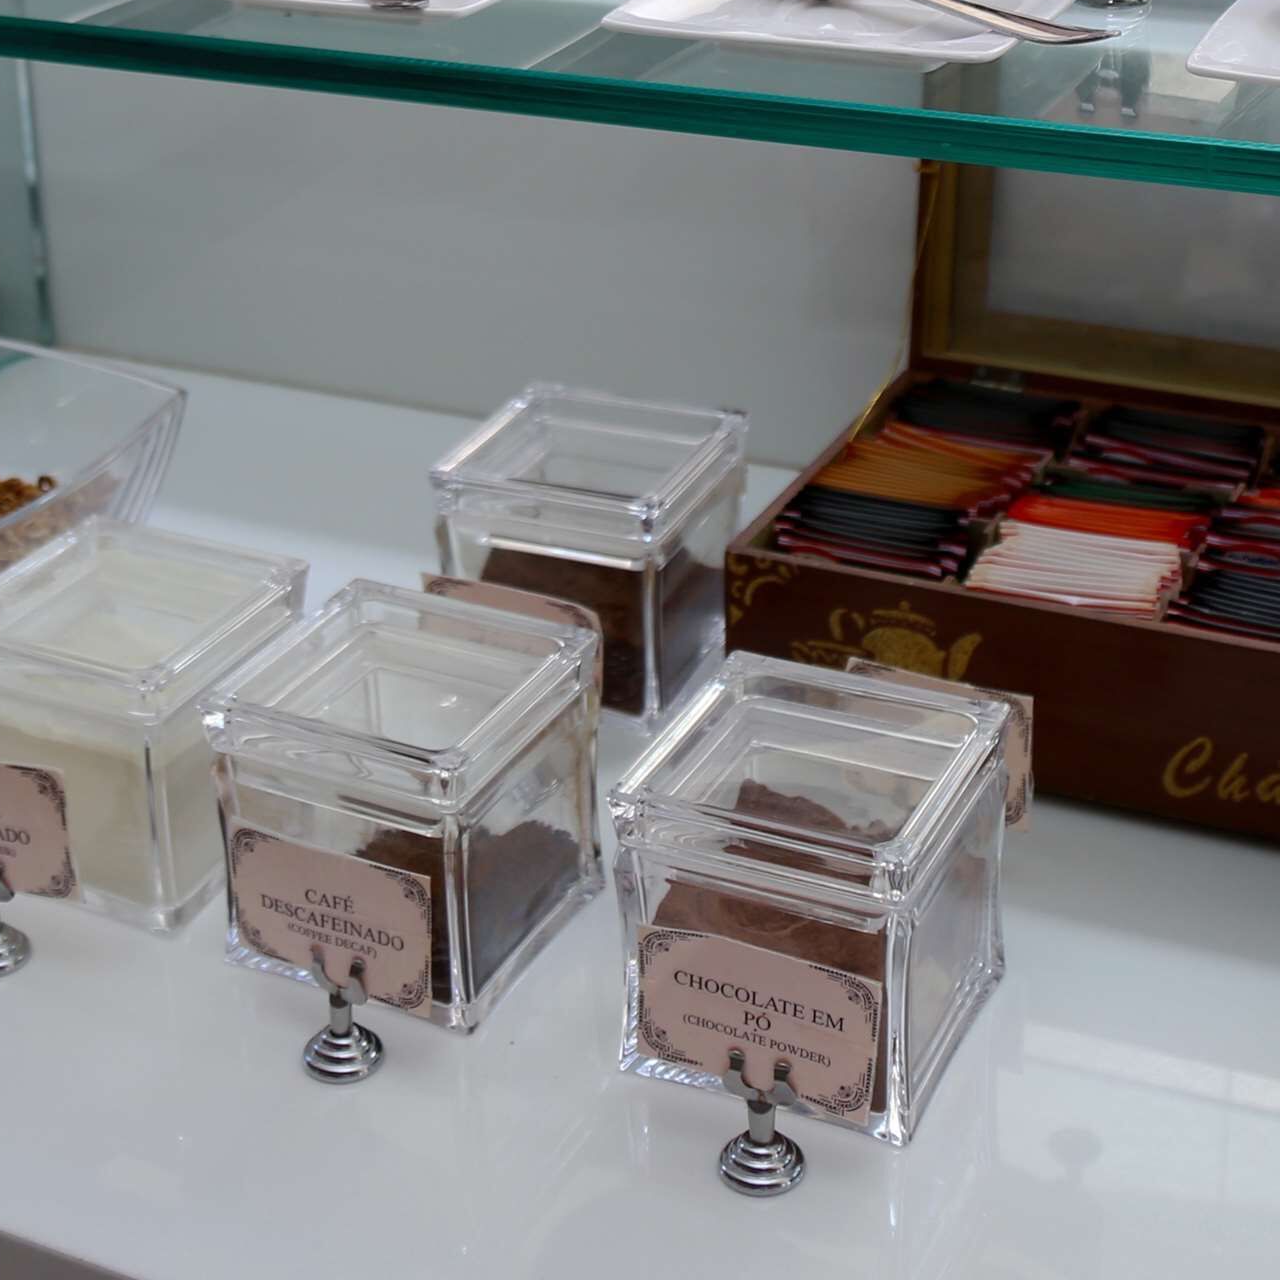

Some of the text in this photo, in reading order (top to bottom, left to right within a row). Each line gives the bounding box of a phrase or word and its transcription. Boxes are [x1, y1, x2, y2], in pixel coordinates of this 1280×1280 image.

[304, 888, 355, 914] CAFÉ
[260, 894, 405, 952] DESCAFEINADO
[335, 936, 377, 959] DECAF)
[673, 969, 845, 1033] CHOCOLATE EM
[743, 1010, 771, 1032] PÓ
[682, 1013, 832, 1068] (CHOCOLATE POWDER)
